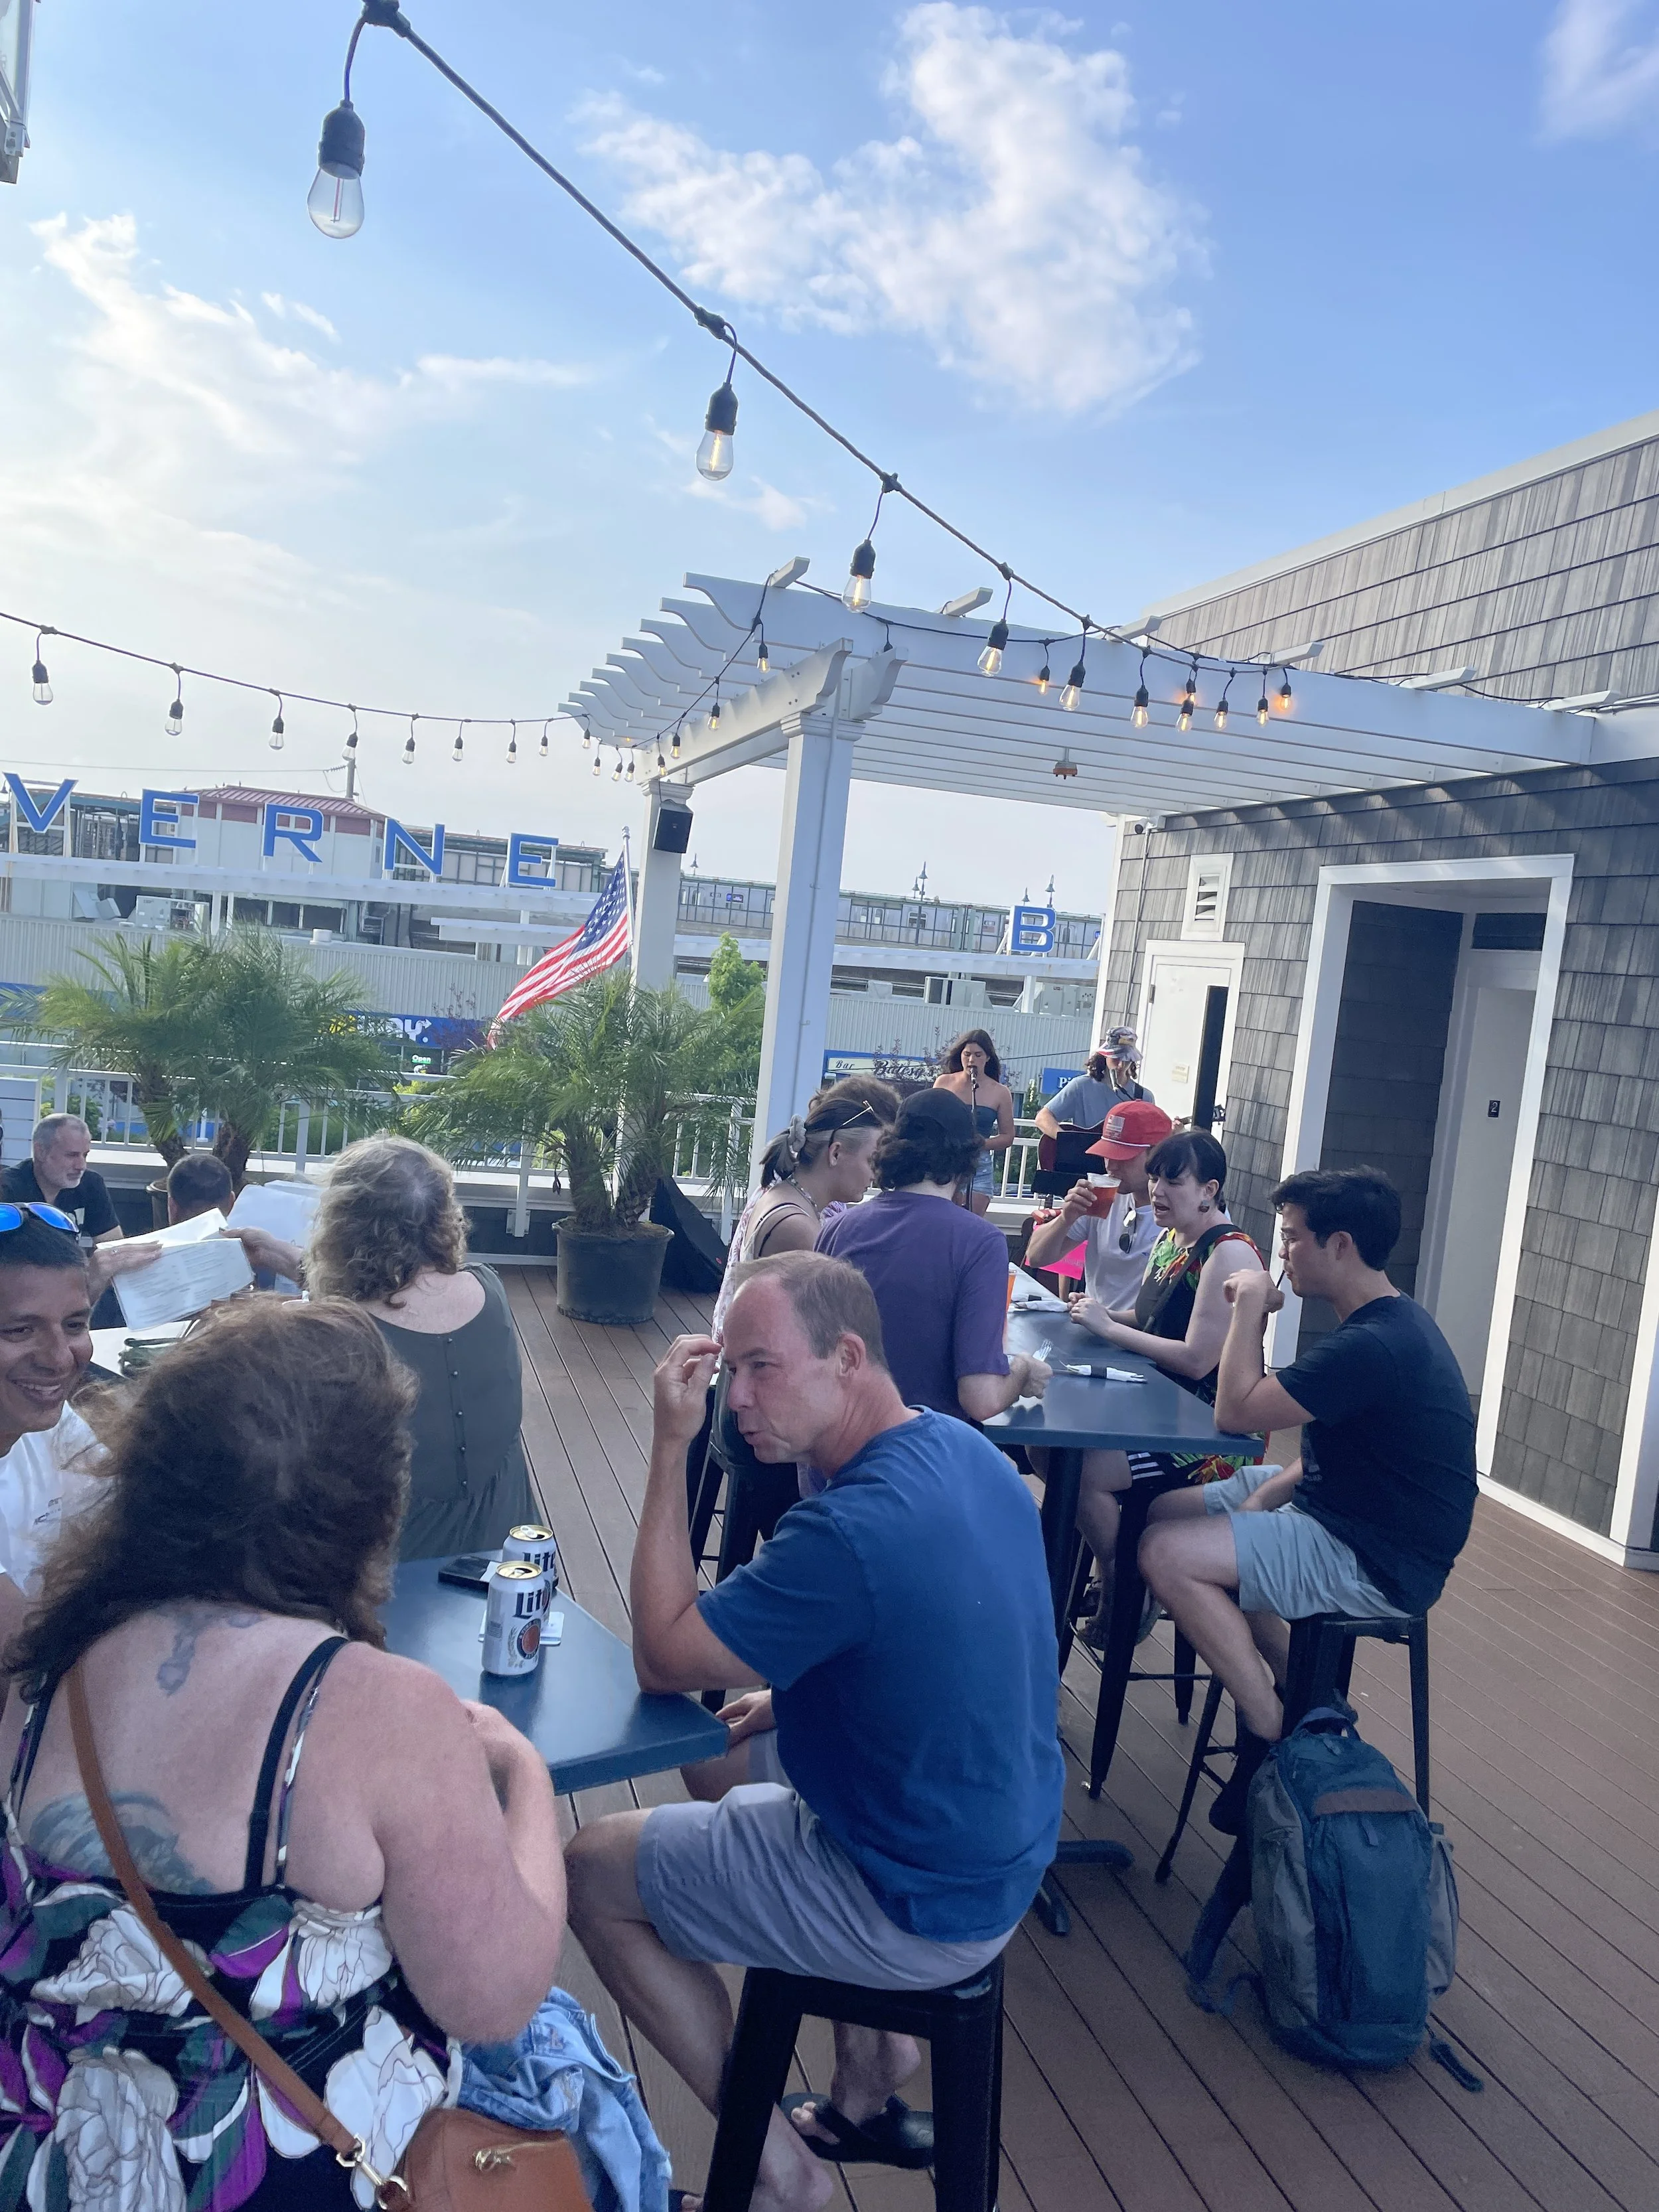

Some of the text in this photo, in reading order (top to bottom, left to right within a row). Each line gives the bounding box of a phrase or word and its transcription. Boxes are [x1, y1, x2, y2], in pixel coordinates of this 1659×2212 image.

[2, 771, 559, 888] VERNE
[412, 1054, 431, 1063] Open
[835, 1059, 855, 1070] Bar
[1491, 1102, 1498, 1112] 2
